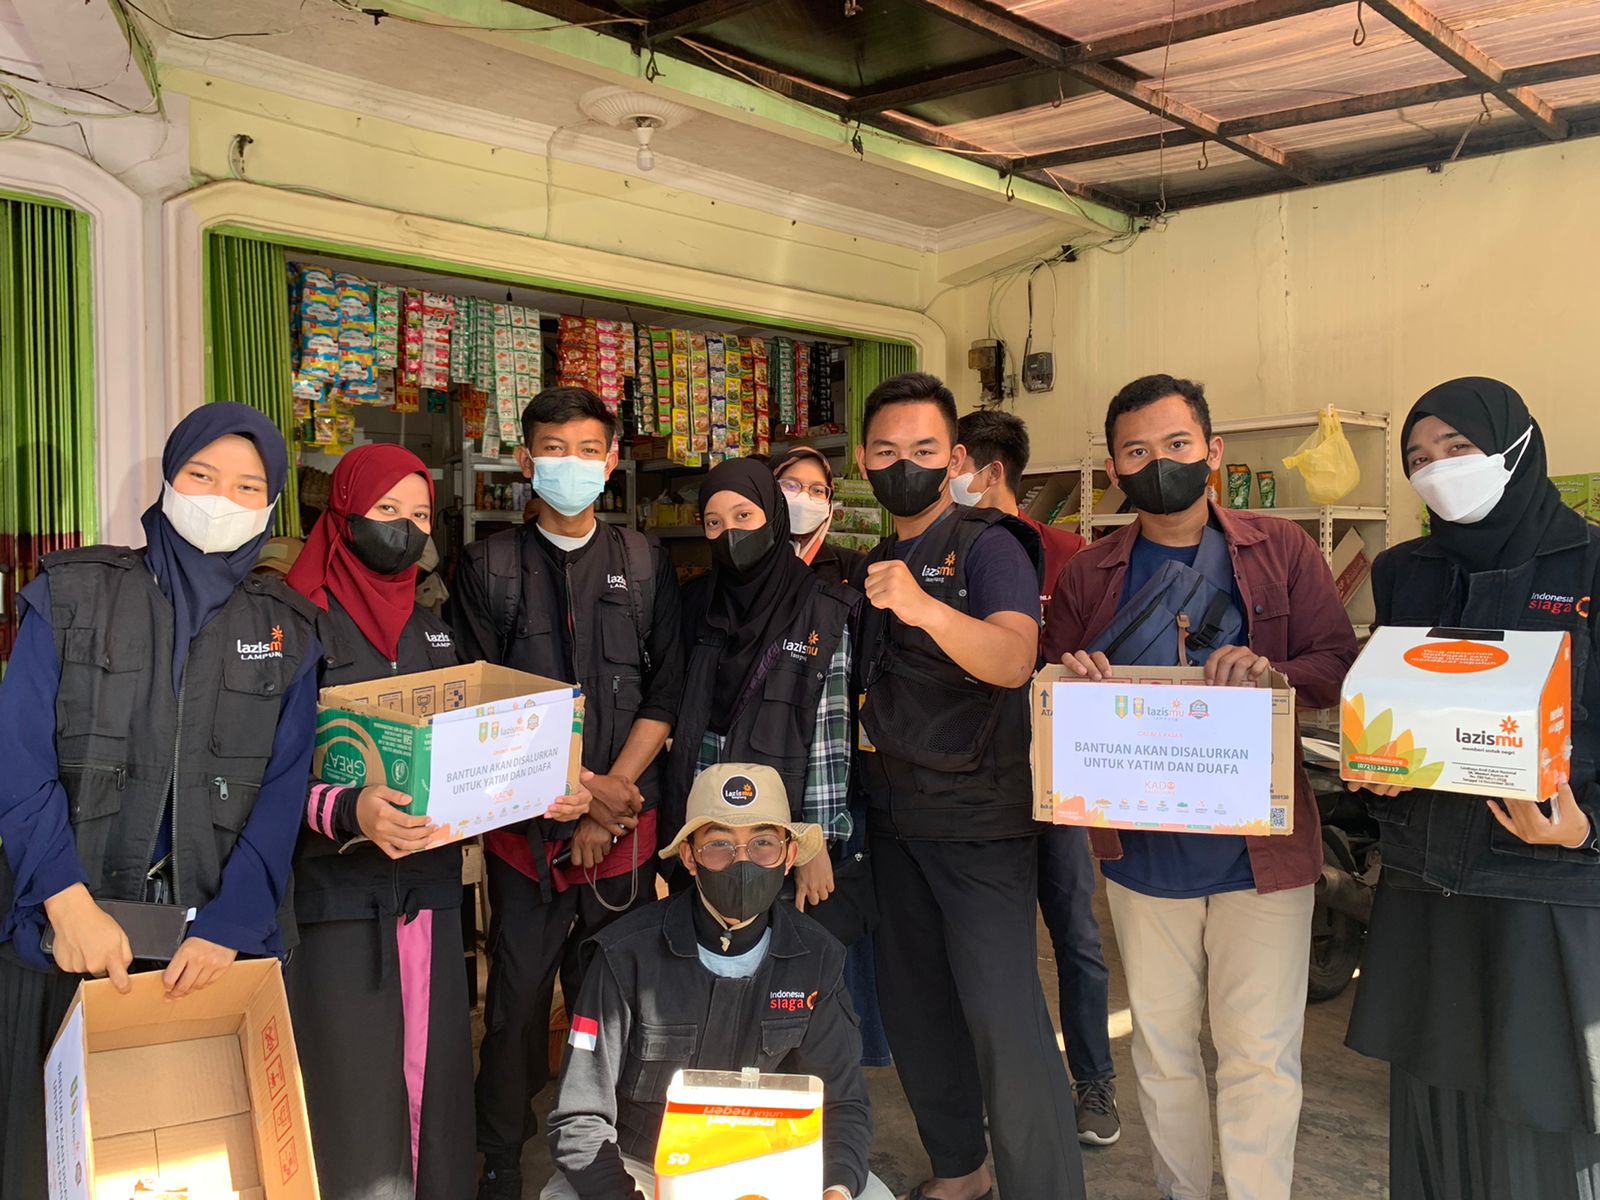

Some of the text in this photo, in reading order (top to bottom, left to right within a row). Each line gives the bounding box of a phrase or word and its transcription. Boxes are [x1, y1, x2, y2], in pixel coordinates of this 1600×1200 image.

[1531, 592, 1574, 603] Indonesia
[1529, 600, 1572, 614] siaga
[237, 639, 283, 653] lazism
[1147, 706, 1185, 717] lazismu
[1456, 728, 1523, 748] lazismu
[1074, 741, 1249, 760] BANTUAN AKAN DISALURKAN
[446, 765, 489, 783] BANTUAN
[489, 758, 512, 773] AKAN
[513, 747, 559, 767] DISALURKAN
[1083, 757, 1239, 775] UNTUK YATIM DAN DUAFA
[453, 761, 552, 795] UNTUK YATIM DAN DUAFA
[770, 990, 805, 999] Indonesia
[770, 998, 804, 1012] siaga
